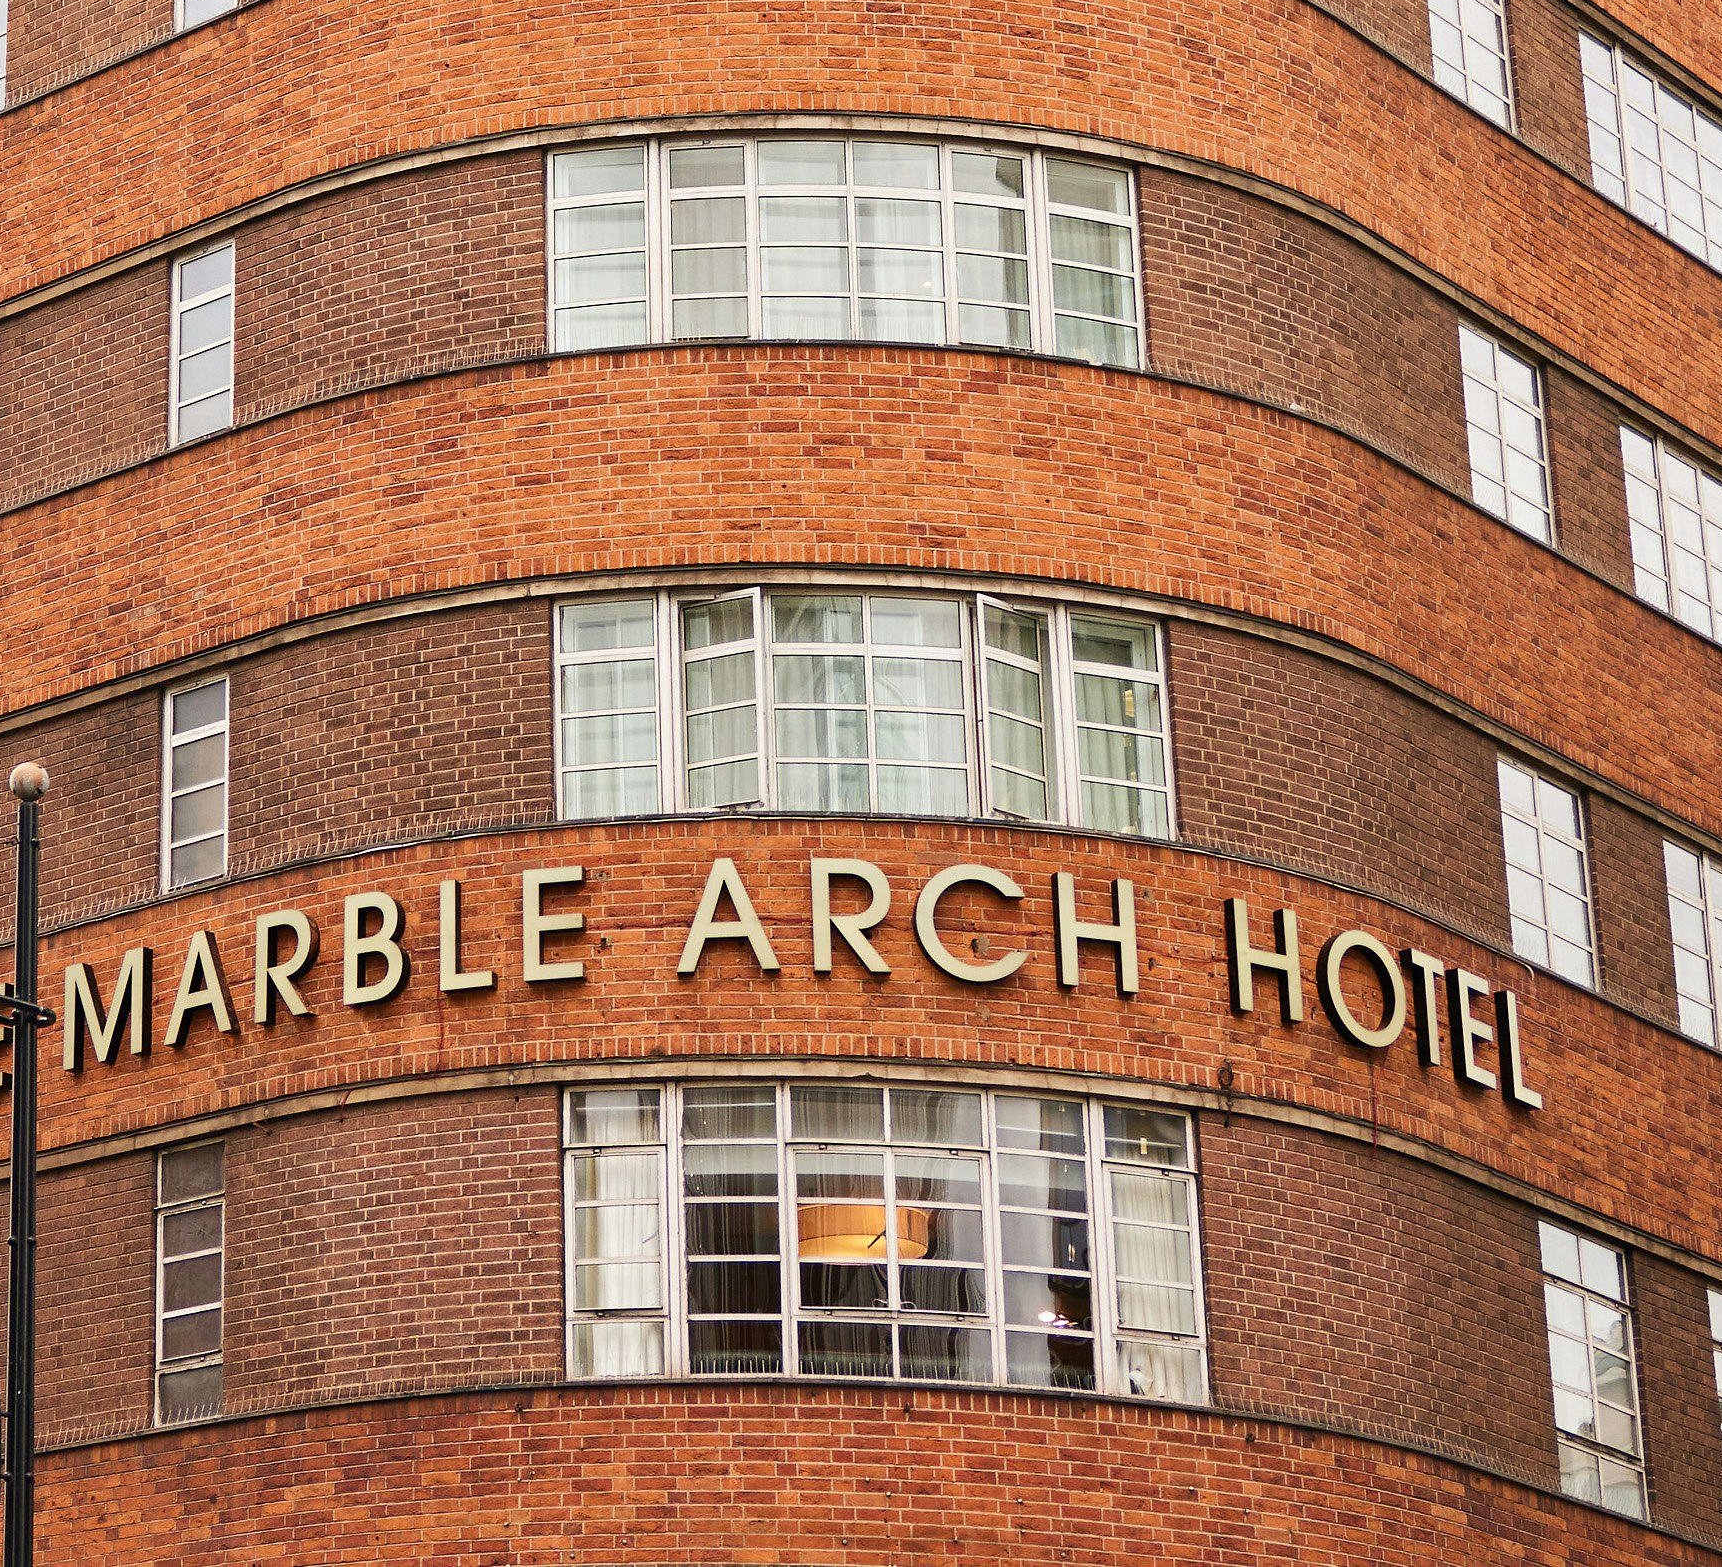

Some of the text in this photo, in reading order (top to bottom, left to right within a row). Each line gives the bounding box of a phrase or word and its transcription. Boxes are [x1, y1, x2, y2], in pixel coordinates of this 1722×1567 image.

[63, 865, 586, 1073] MARBLE
[677, 857, 1139, 995] ARCH
[1225, 897, 1543, 1111] HOTEL
